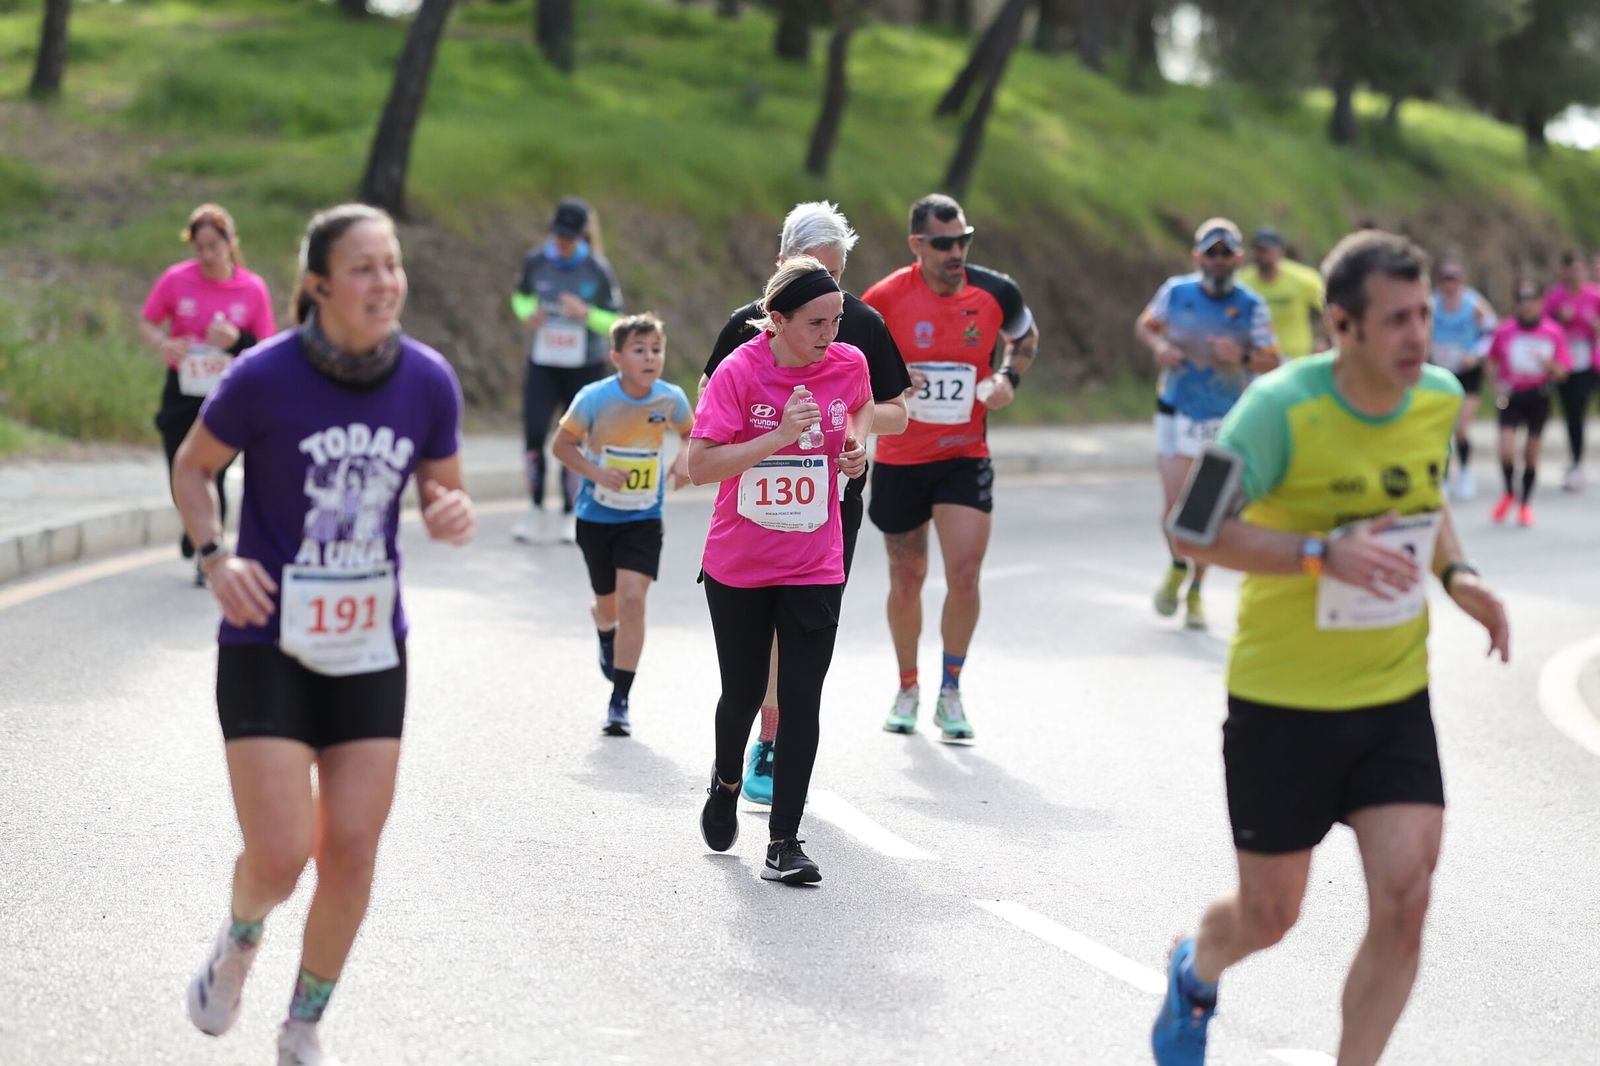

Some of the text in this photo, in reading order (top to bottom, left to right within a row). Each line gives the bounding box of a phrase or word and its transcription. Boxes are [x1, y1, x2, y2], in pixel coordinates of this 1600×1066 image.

[917, 379, 965, 401] 312
[750, 418, 779, 427] HYUNDAI
[298, 422, 415, 472] TODAS
[755, 476, 815, 506] 130
[294, 538, 321, 565] A
[308, 594, 377, 635] 191
